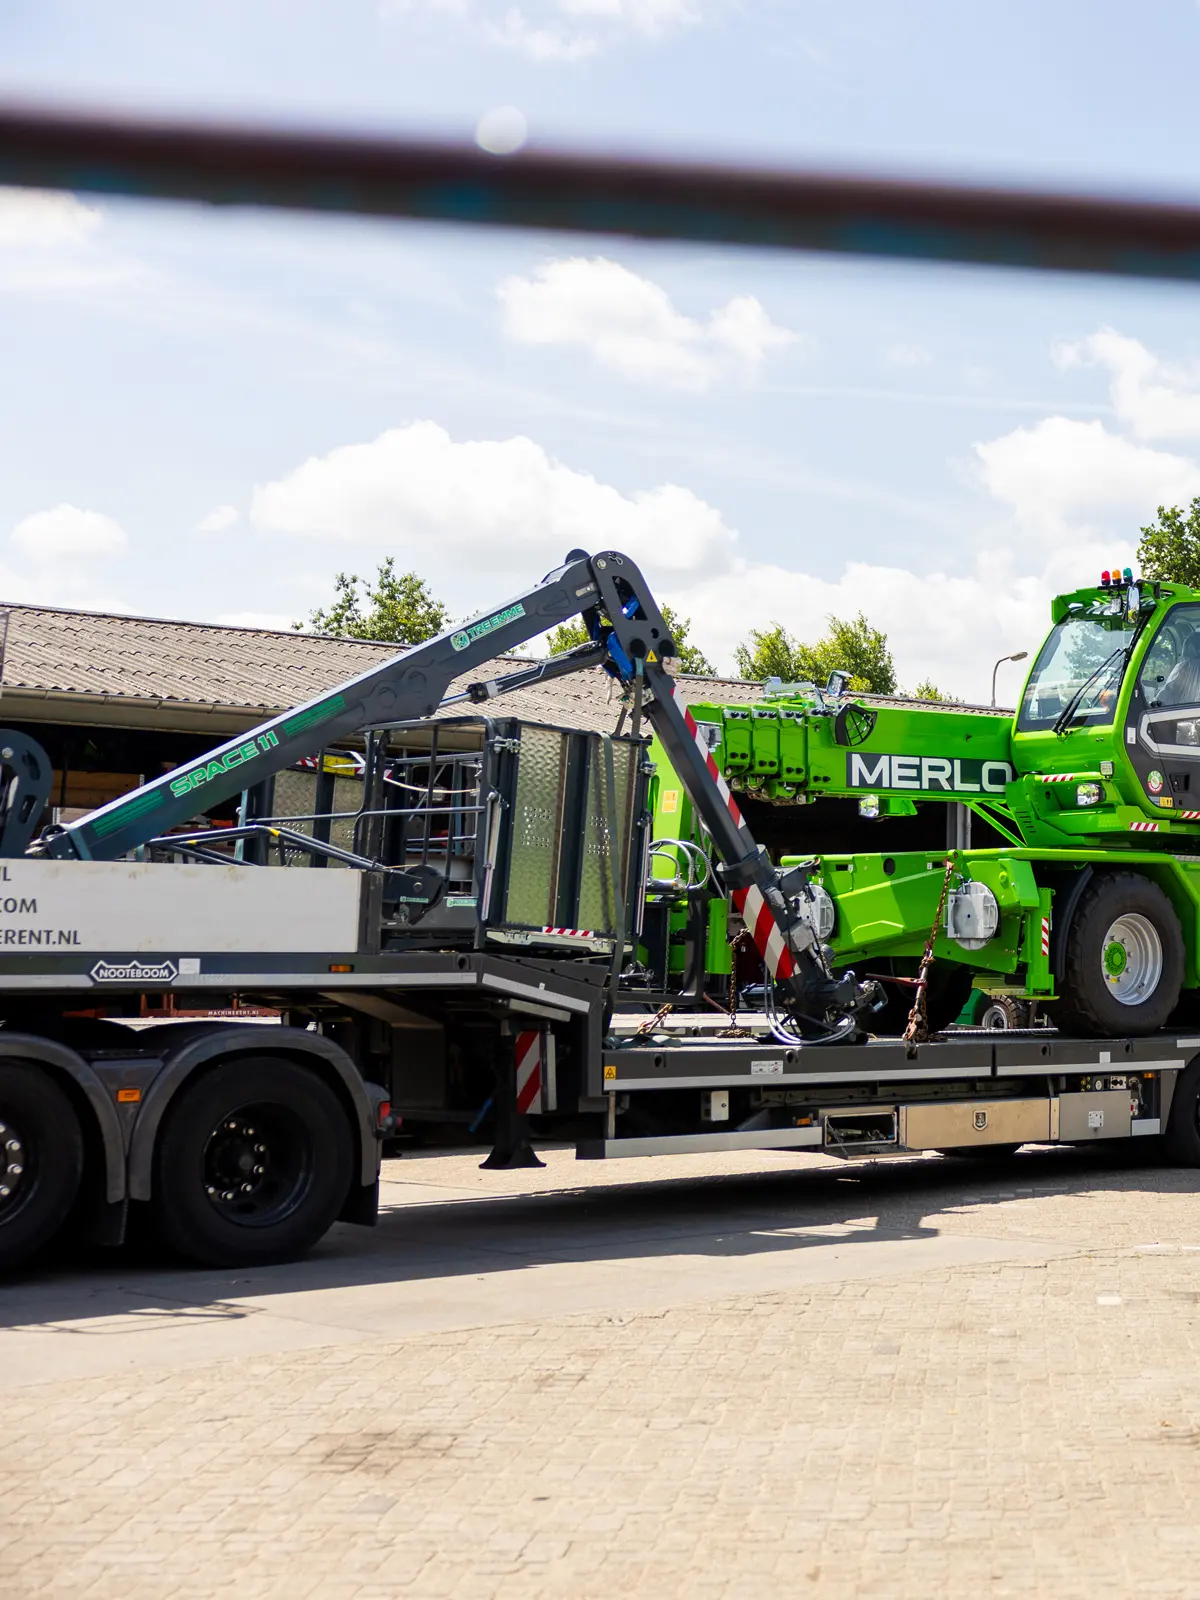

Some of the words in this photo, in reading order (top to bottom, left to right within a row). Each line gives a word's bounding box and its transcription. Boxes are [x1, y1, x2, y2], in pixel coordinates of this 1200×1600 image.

[169, 740, 260, 798] SPACE
[257, 730, 279, 751] 11
[851, 753, 1013, 793] MERLO
[99, 968, 169, 979] NOOTEBOOM
